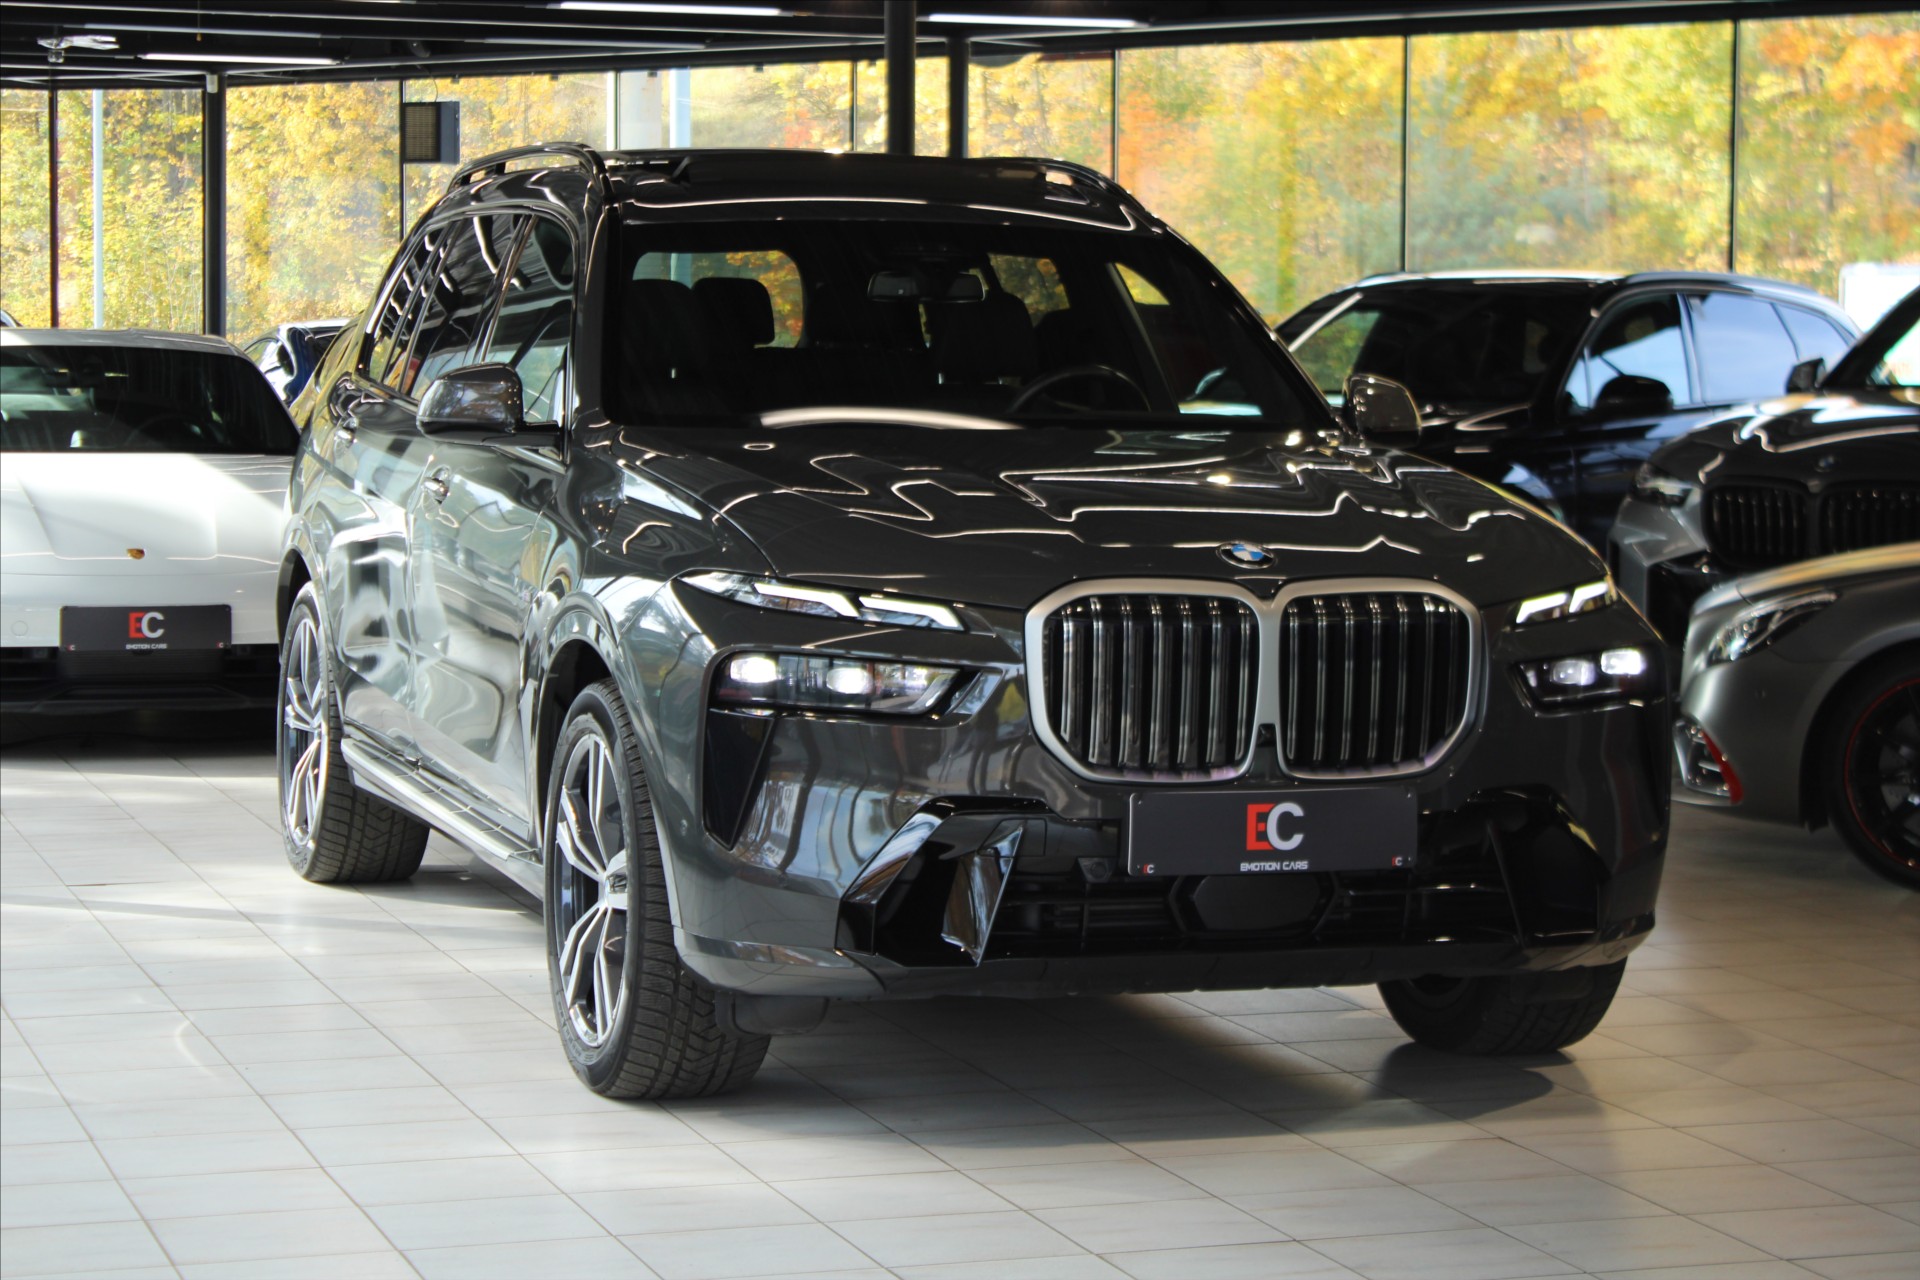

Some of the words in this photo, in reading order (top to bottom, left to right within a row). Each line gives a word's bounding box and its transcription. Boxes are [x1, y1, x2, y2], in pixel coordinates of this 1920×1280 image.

[128, 611, 165, 639] EC
[1246, 802, 1304, 851] EC
[1240, 861, 1281, 872] EMOTION
[1282, 860, 1309, 871] CARS
